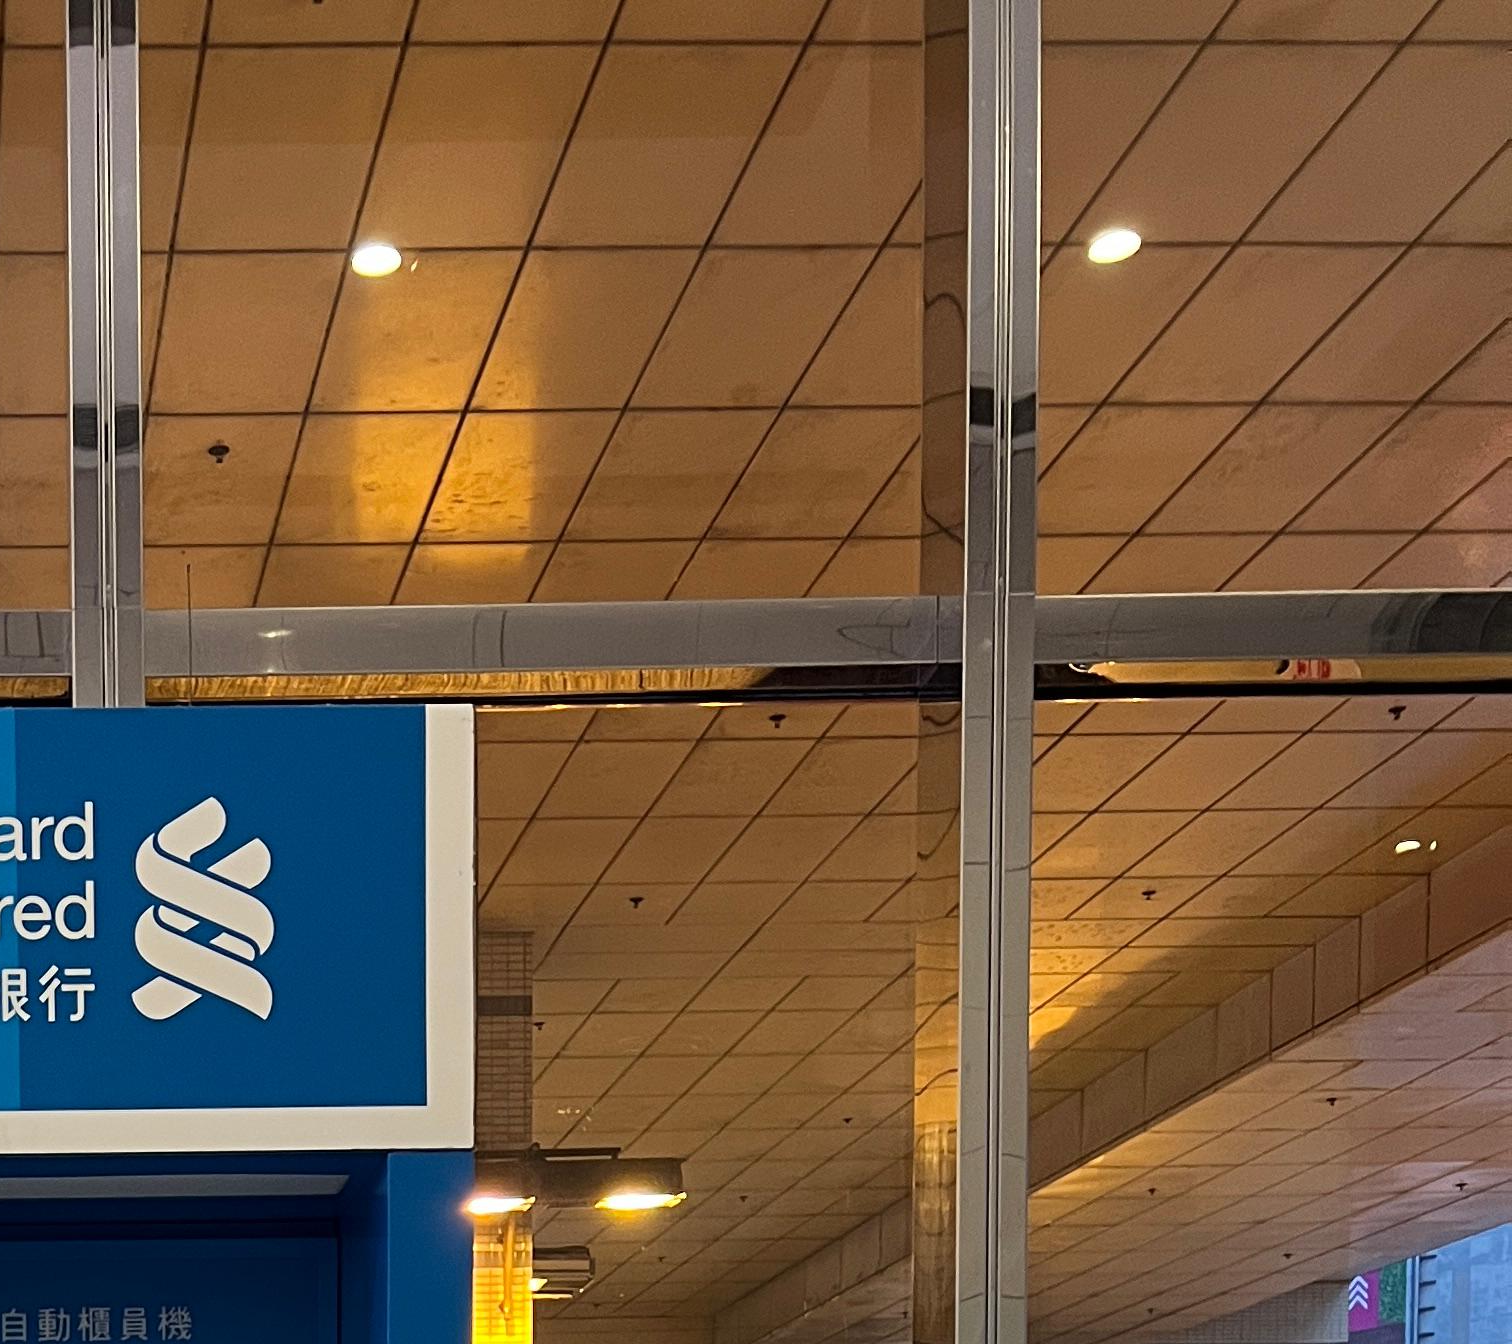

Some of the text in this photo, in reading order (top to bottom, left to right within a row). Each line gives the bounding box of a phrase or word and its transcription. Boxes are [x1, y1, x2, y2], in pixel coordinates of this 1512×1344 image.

[0, 1305, 193, 1343] 自動櫃員機
